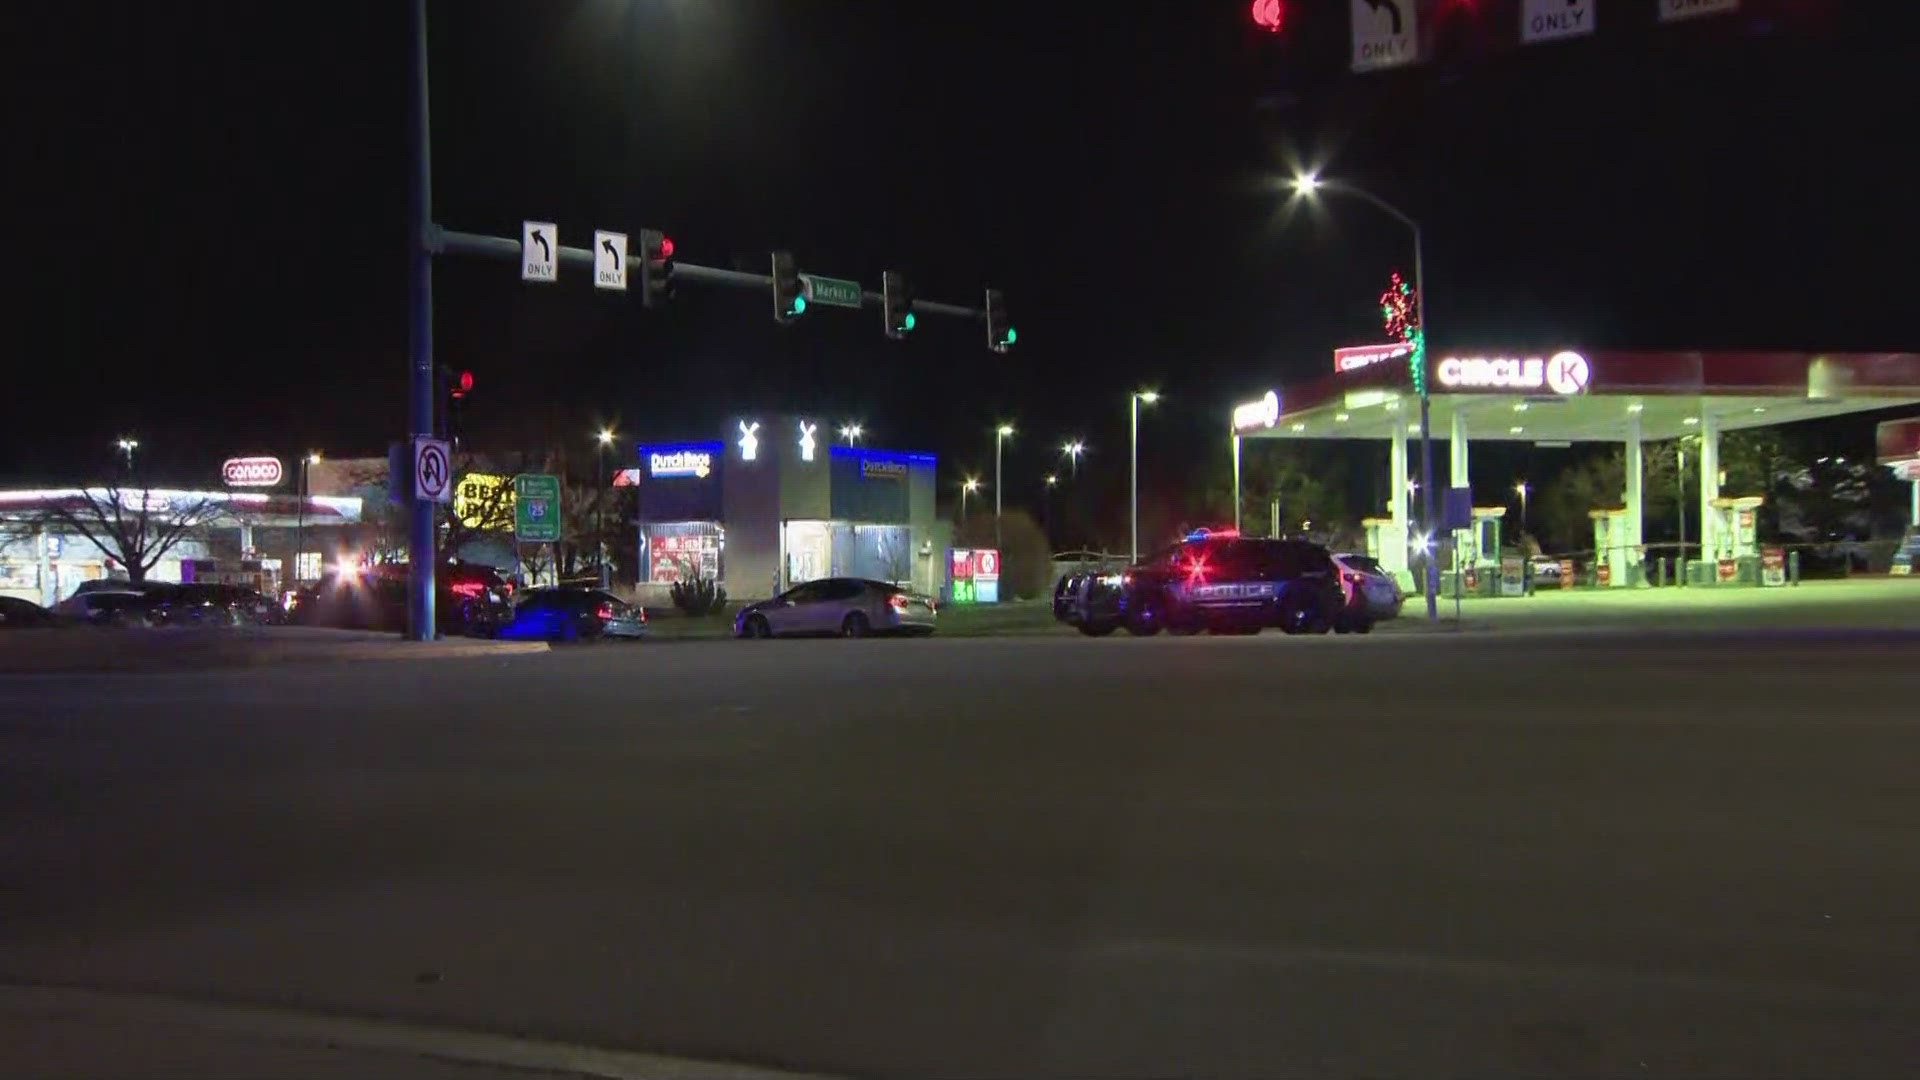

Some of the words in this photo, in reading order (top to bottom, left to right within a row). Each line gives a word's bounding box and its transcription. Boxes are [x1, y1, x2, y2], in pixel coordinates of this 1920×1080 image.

[1532, 9, 1584, 33] ONLY
[1362, 38, 1409, 58] ONLY
[528, 263, 552, 276] ONLY
[600, 271, 622, 284] ONLY
[816, 283, 847, 299] Market
[1438, 357, 1544, 388] CIRCLE
[1200, 583, 1273, 597] POLICE
